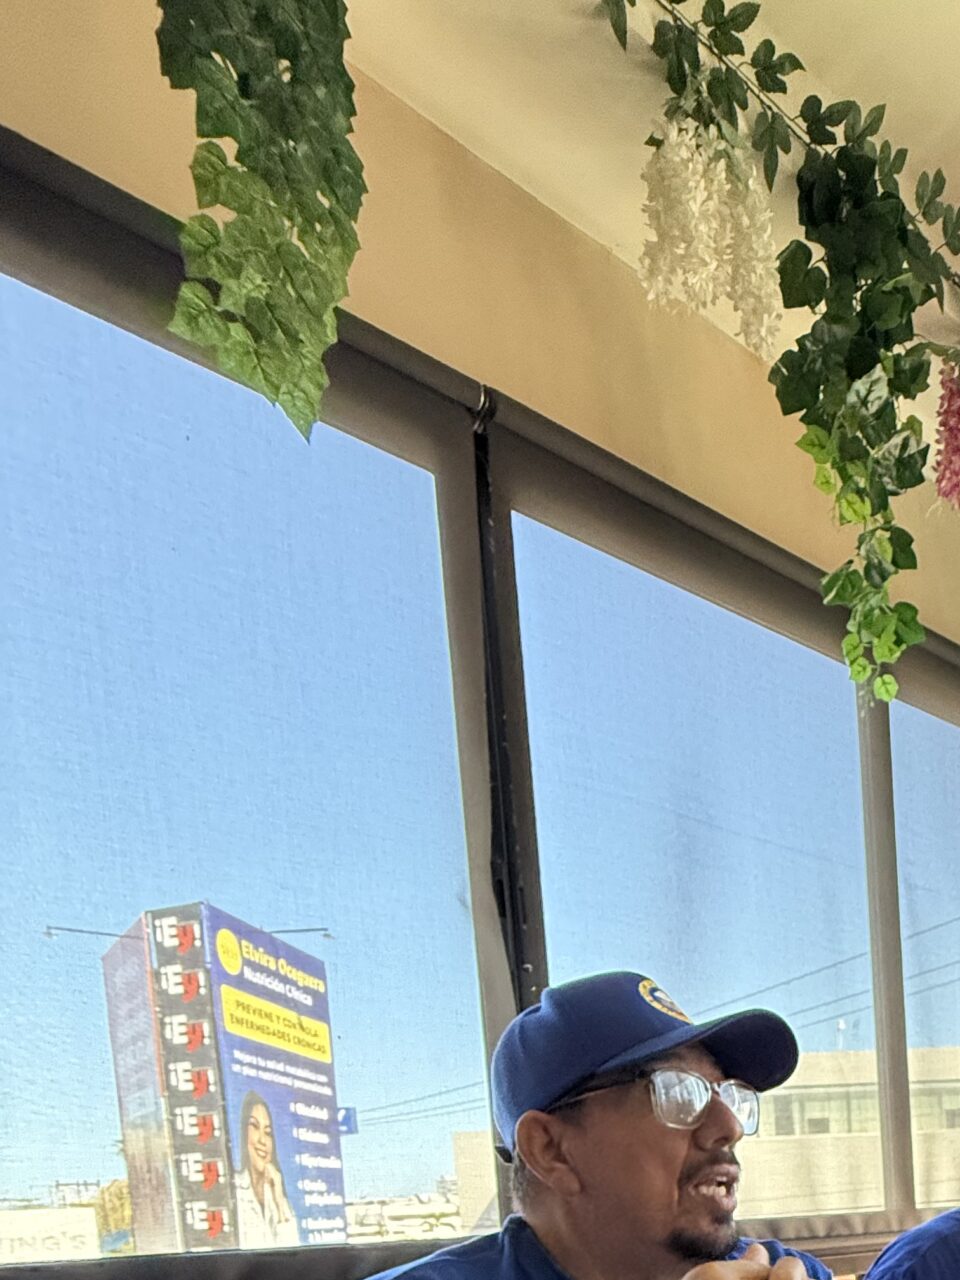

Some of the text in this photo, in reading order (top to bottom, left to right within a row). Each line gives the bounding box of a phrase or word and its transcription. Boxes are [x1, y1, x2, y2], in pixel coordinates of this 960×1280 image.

[241, 939, 277, 971] Elvira
[235, 1000, 274, 1023] PREVIENE
[229, 1013, 291, 1044] ENFERMEDADES
